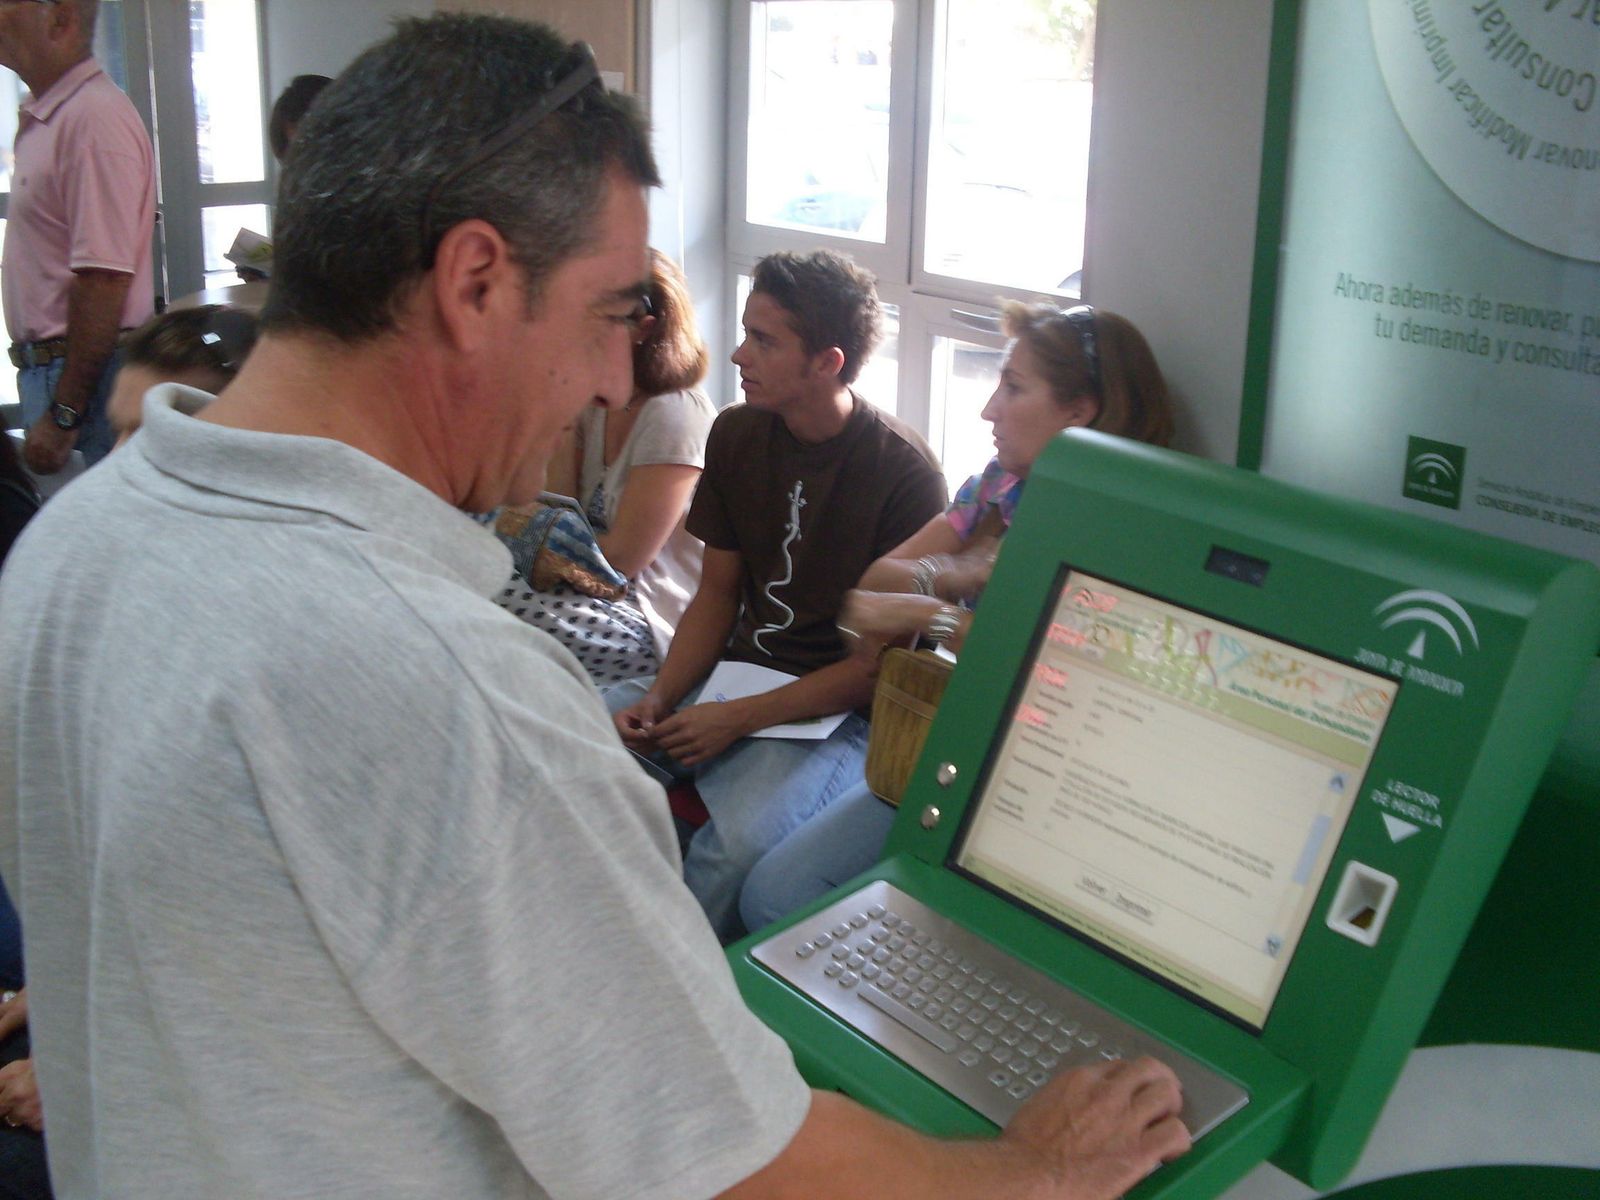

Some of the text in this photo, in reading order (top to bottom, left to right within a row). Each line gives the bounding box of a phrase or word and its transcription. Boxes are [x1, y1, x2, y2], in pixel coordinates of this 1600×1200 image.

[1407, 0, 1600, 171] novar Modificar Imprim
[1472, 0, 1596, 113] Consultar
[1334, 271, 1385, 304] Ahora
[1389, 281, 1464, 316] además
[1467, 292, 1492, 320] de
[1375, 312, 1394, 339] tu
[1399, 316, 1491, 357] demanda
[1495, 339, 1510, 365] y
